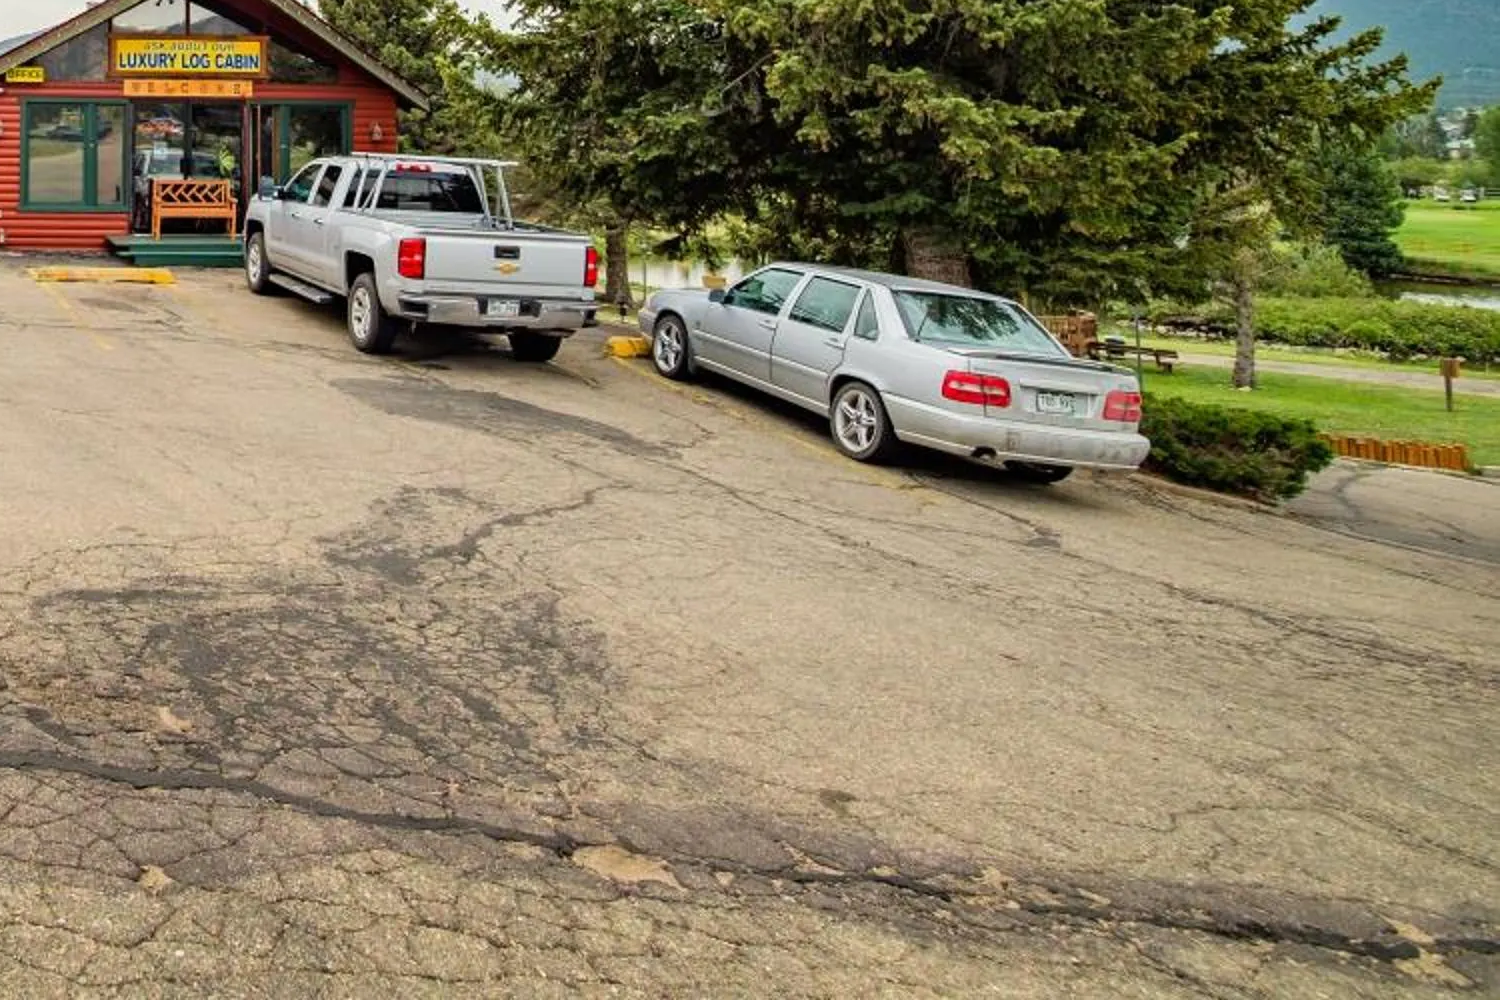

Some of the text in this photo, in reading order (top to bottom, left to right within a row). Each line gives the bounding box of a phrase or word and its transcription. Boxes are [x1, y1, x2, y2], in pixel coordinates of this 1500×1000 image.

[119, 53, 260, 70] LUXURY LOG CABIN
[7, 69, 43, 79] OFFICE
